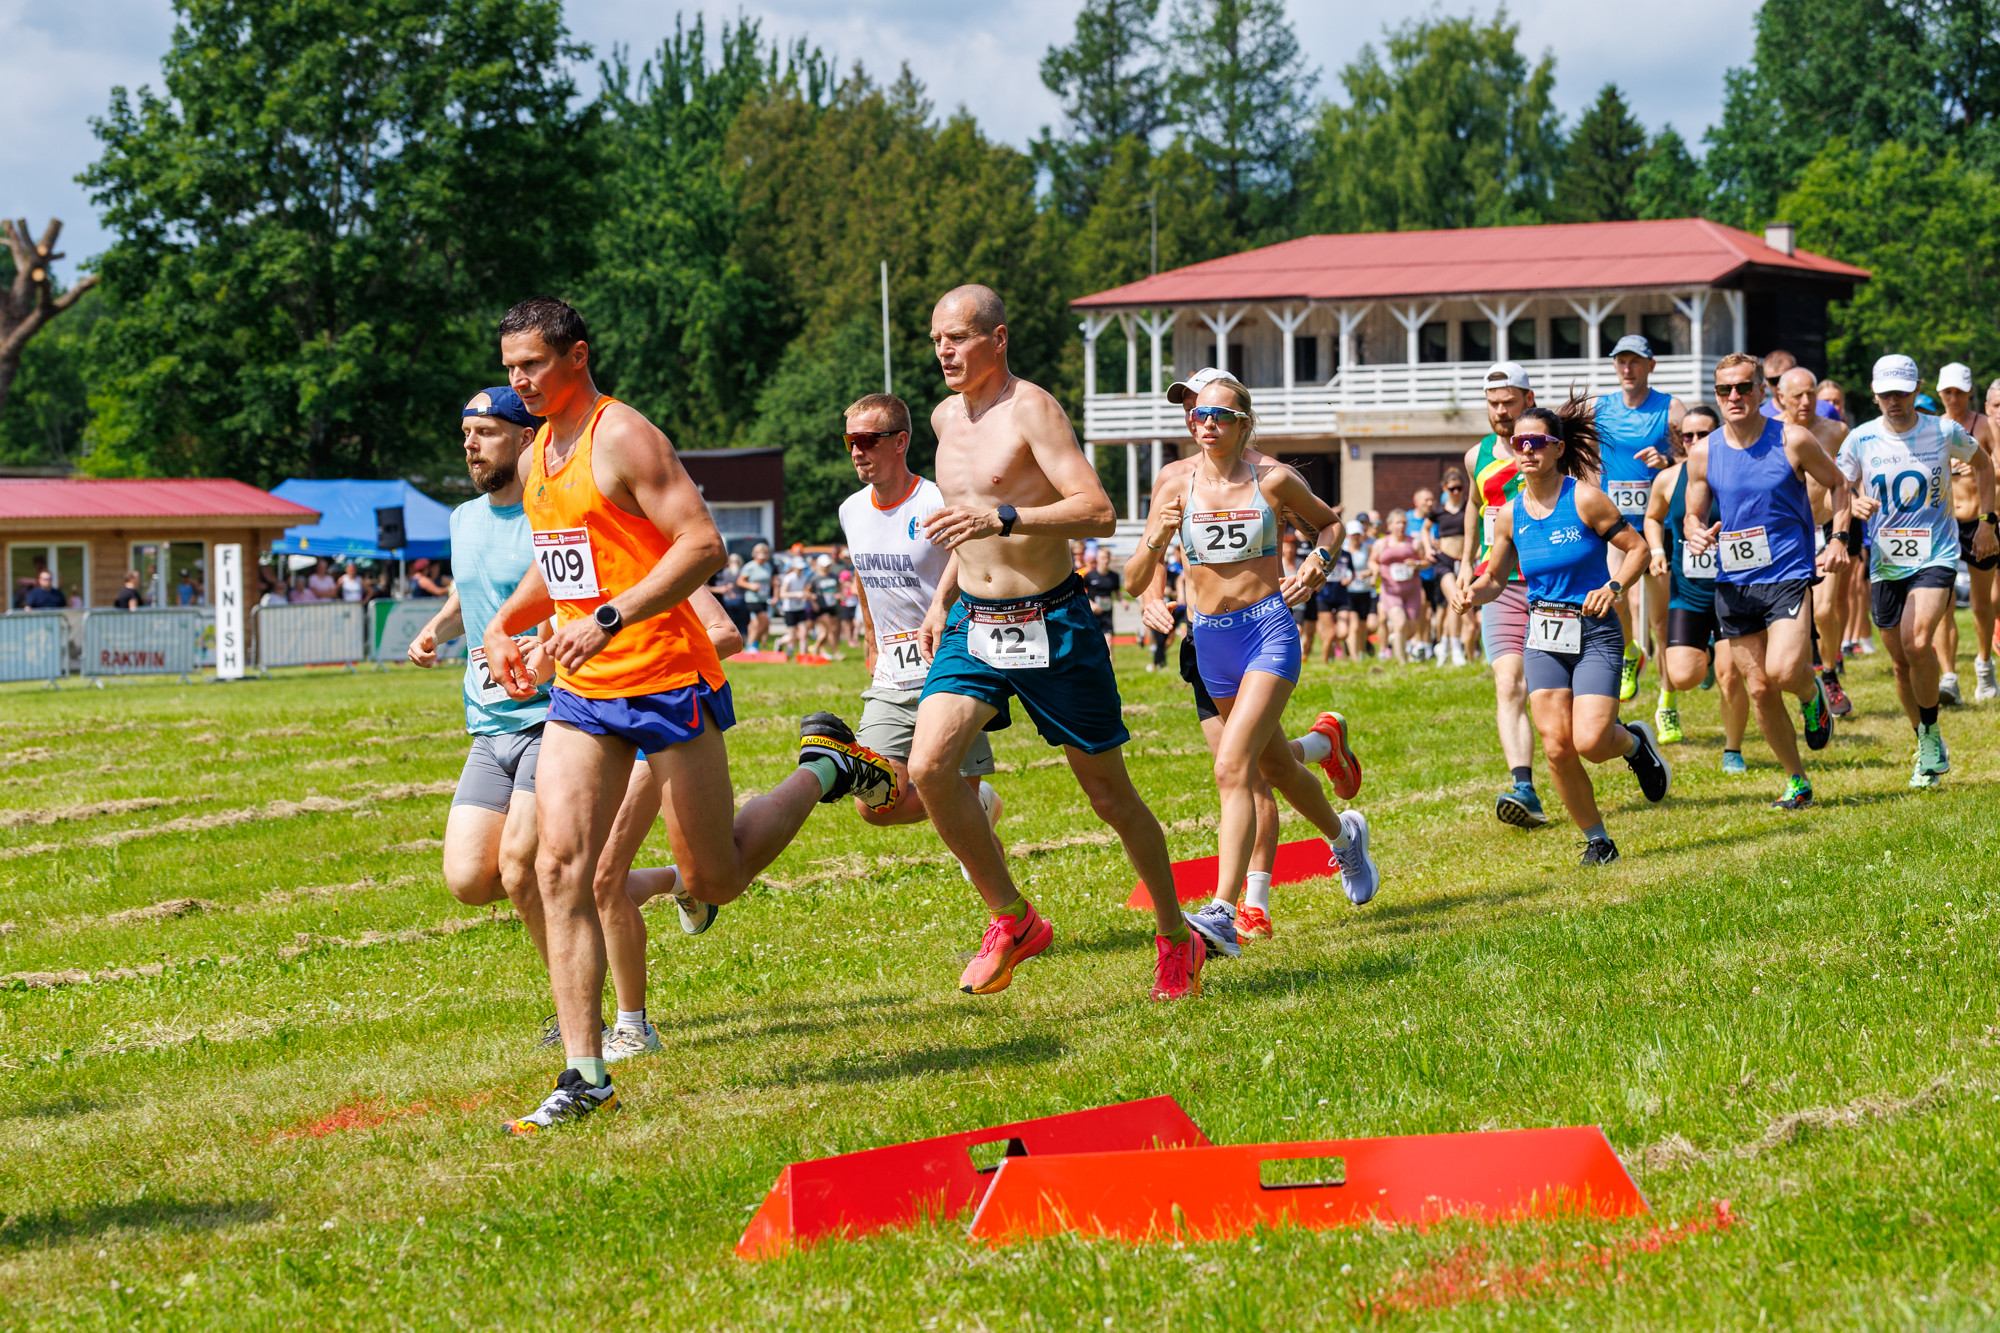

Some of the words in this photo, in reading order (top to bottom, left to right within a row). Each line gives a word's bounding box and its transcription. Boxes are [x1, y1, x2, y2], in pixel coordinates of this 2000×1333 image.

[1882, 454, 1901, 465] edp
[1613, 491, 1647, 507] 130
[1871, 470, 1927, 515] 10
[1931, 466, 1941, 509] ANOS
[1205, 523, 1248, 550] 25
[1890, 539, 1919, 557] 28
[854, 553, 914, 571] SIMUNA
[1689, 553, 1719, 569] 10
[1729, 541, 1755, 561] 18
[540, 548, 585, 583] 109
[223, 549, 235, 668] FINISH
[1199, 616, 1233, 629] PRO
[1242, 596, 1283, 623] NIKE
[989, 627, 1027, 654] 12
[1541, 619, 1563, 641] 17
[101, 650, 165, 668] RAKWIN
[893, 643, 923, 669] 14
[479, 661, 498, 691] 2
[805, 737, 847, 752] SALOMON
